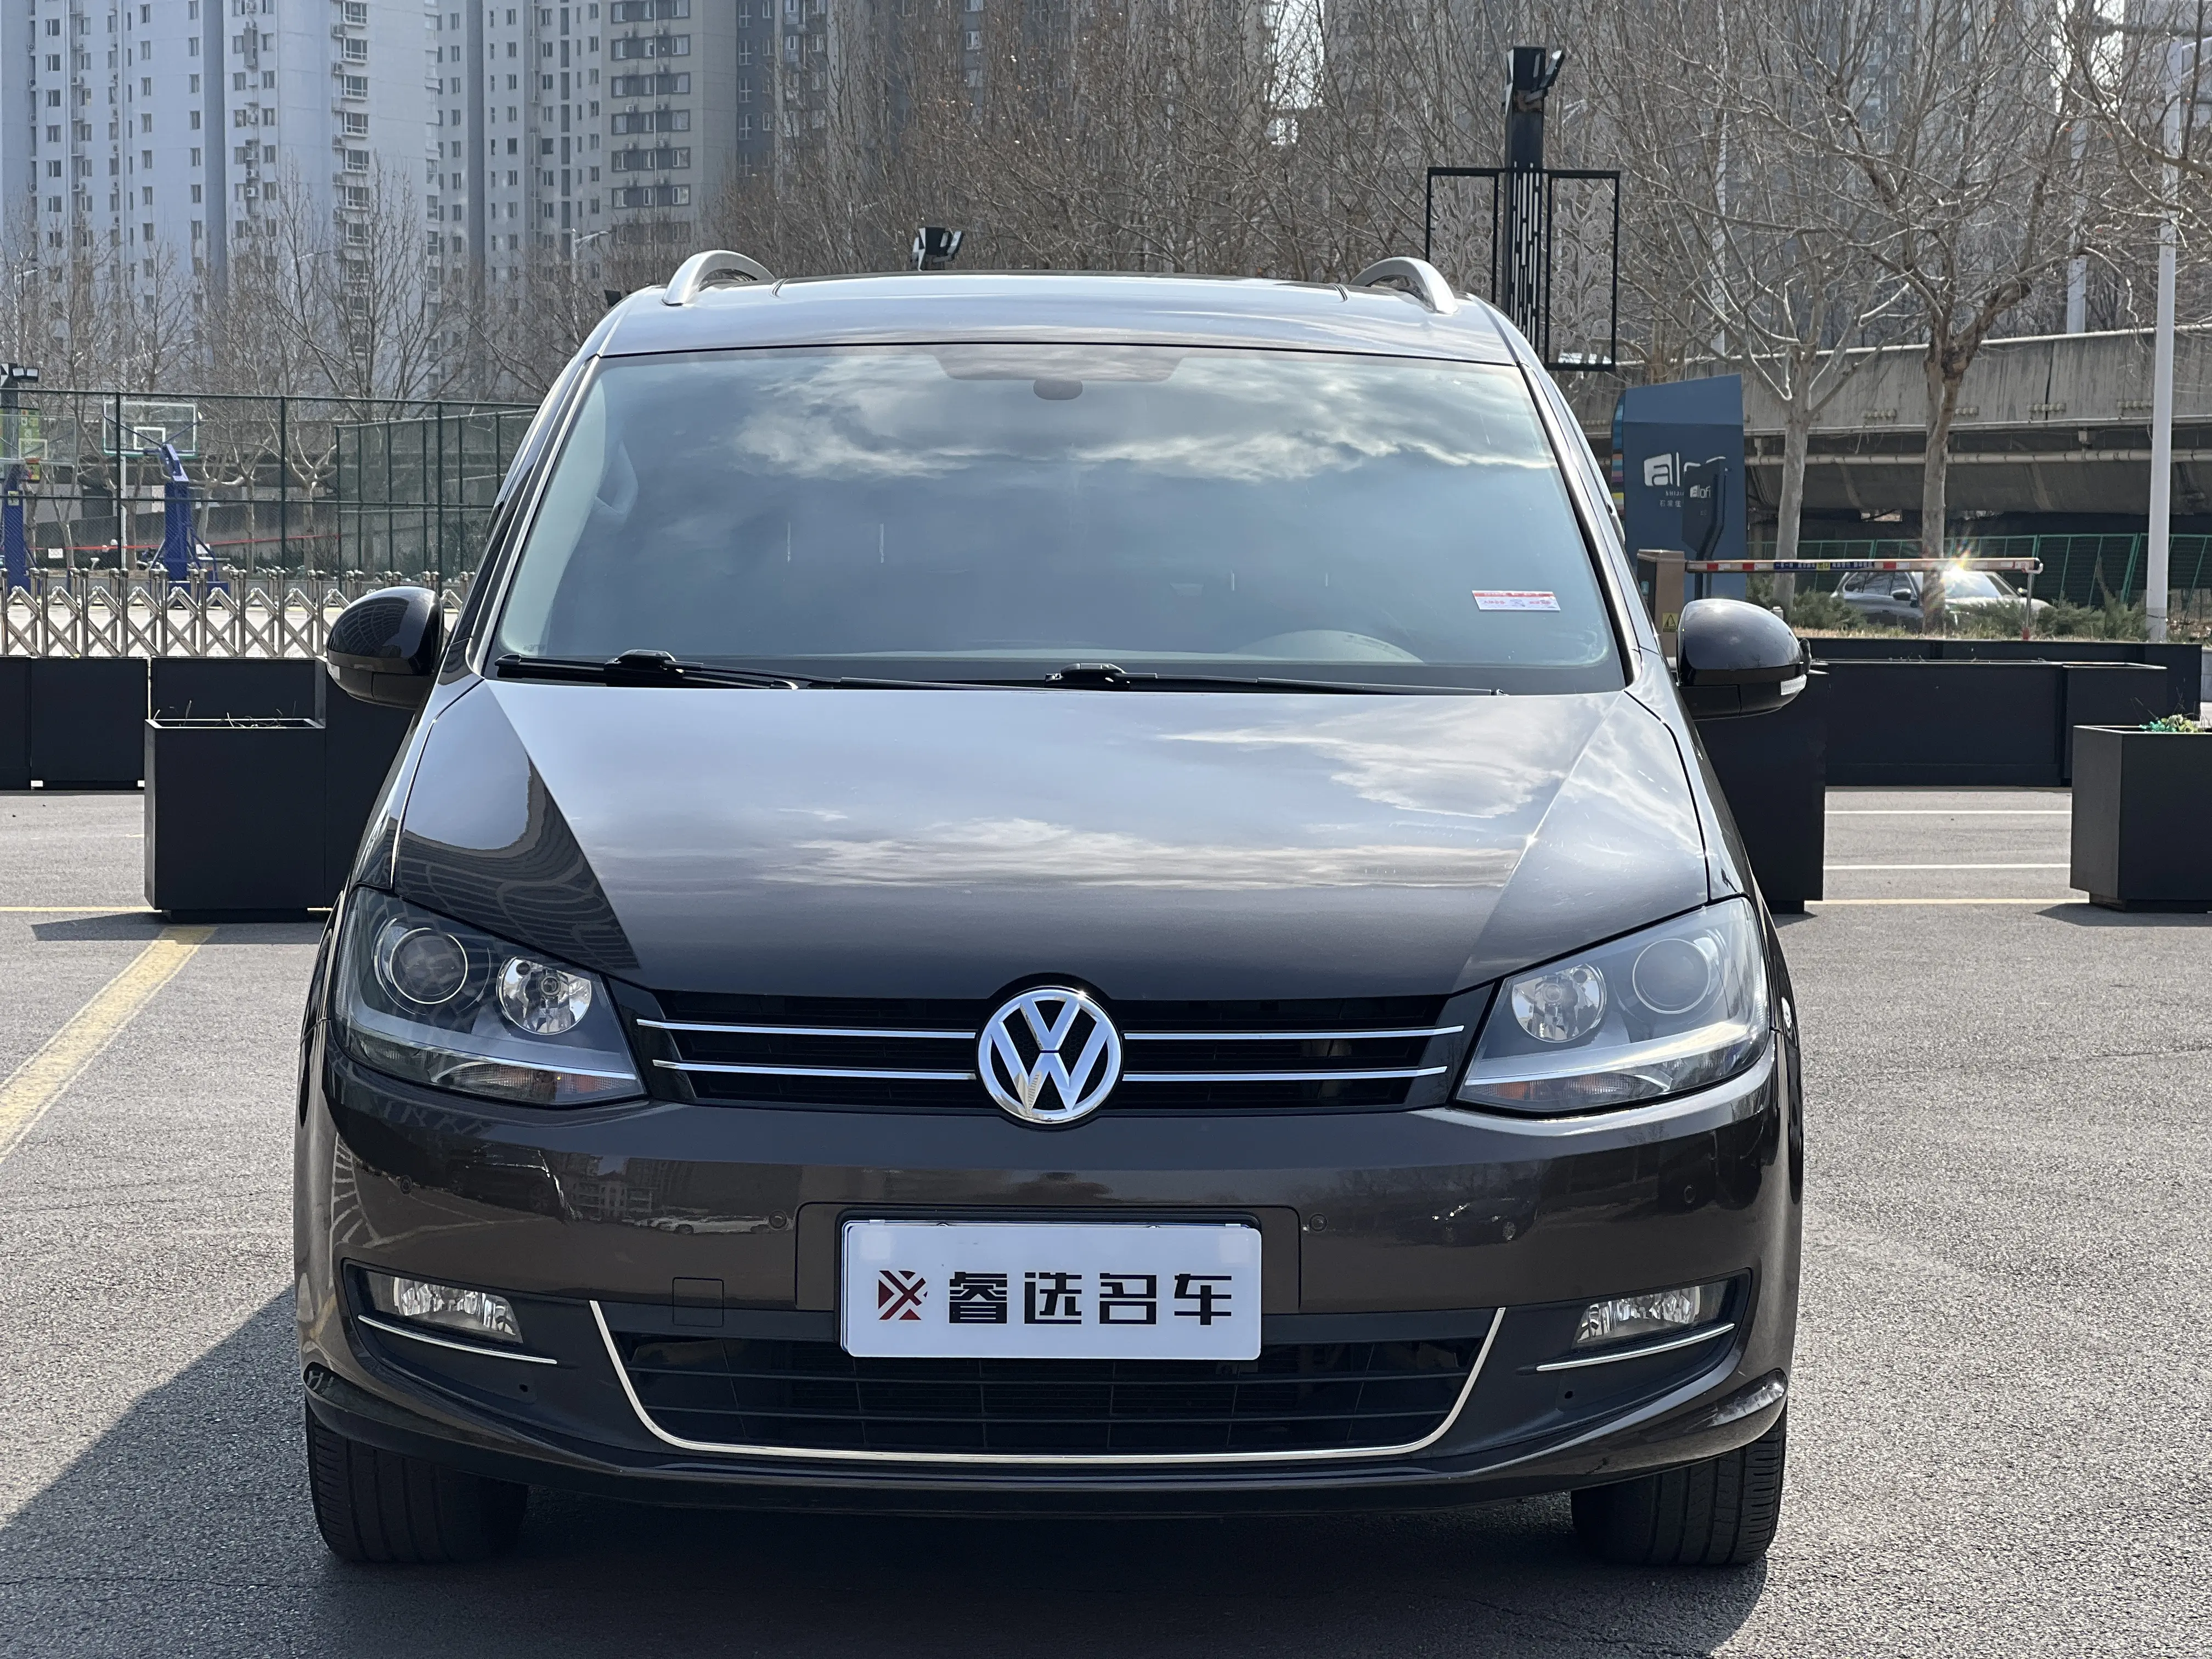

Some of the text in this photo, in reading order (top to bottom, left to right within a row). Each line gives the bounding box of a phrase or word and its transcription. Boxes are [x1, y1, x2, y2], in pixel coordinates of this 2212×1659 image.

[981, 991, 1119, 1118] VW
[950, 1272, 1232, 1325] 睿选名车
